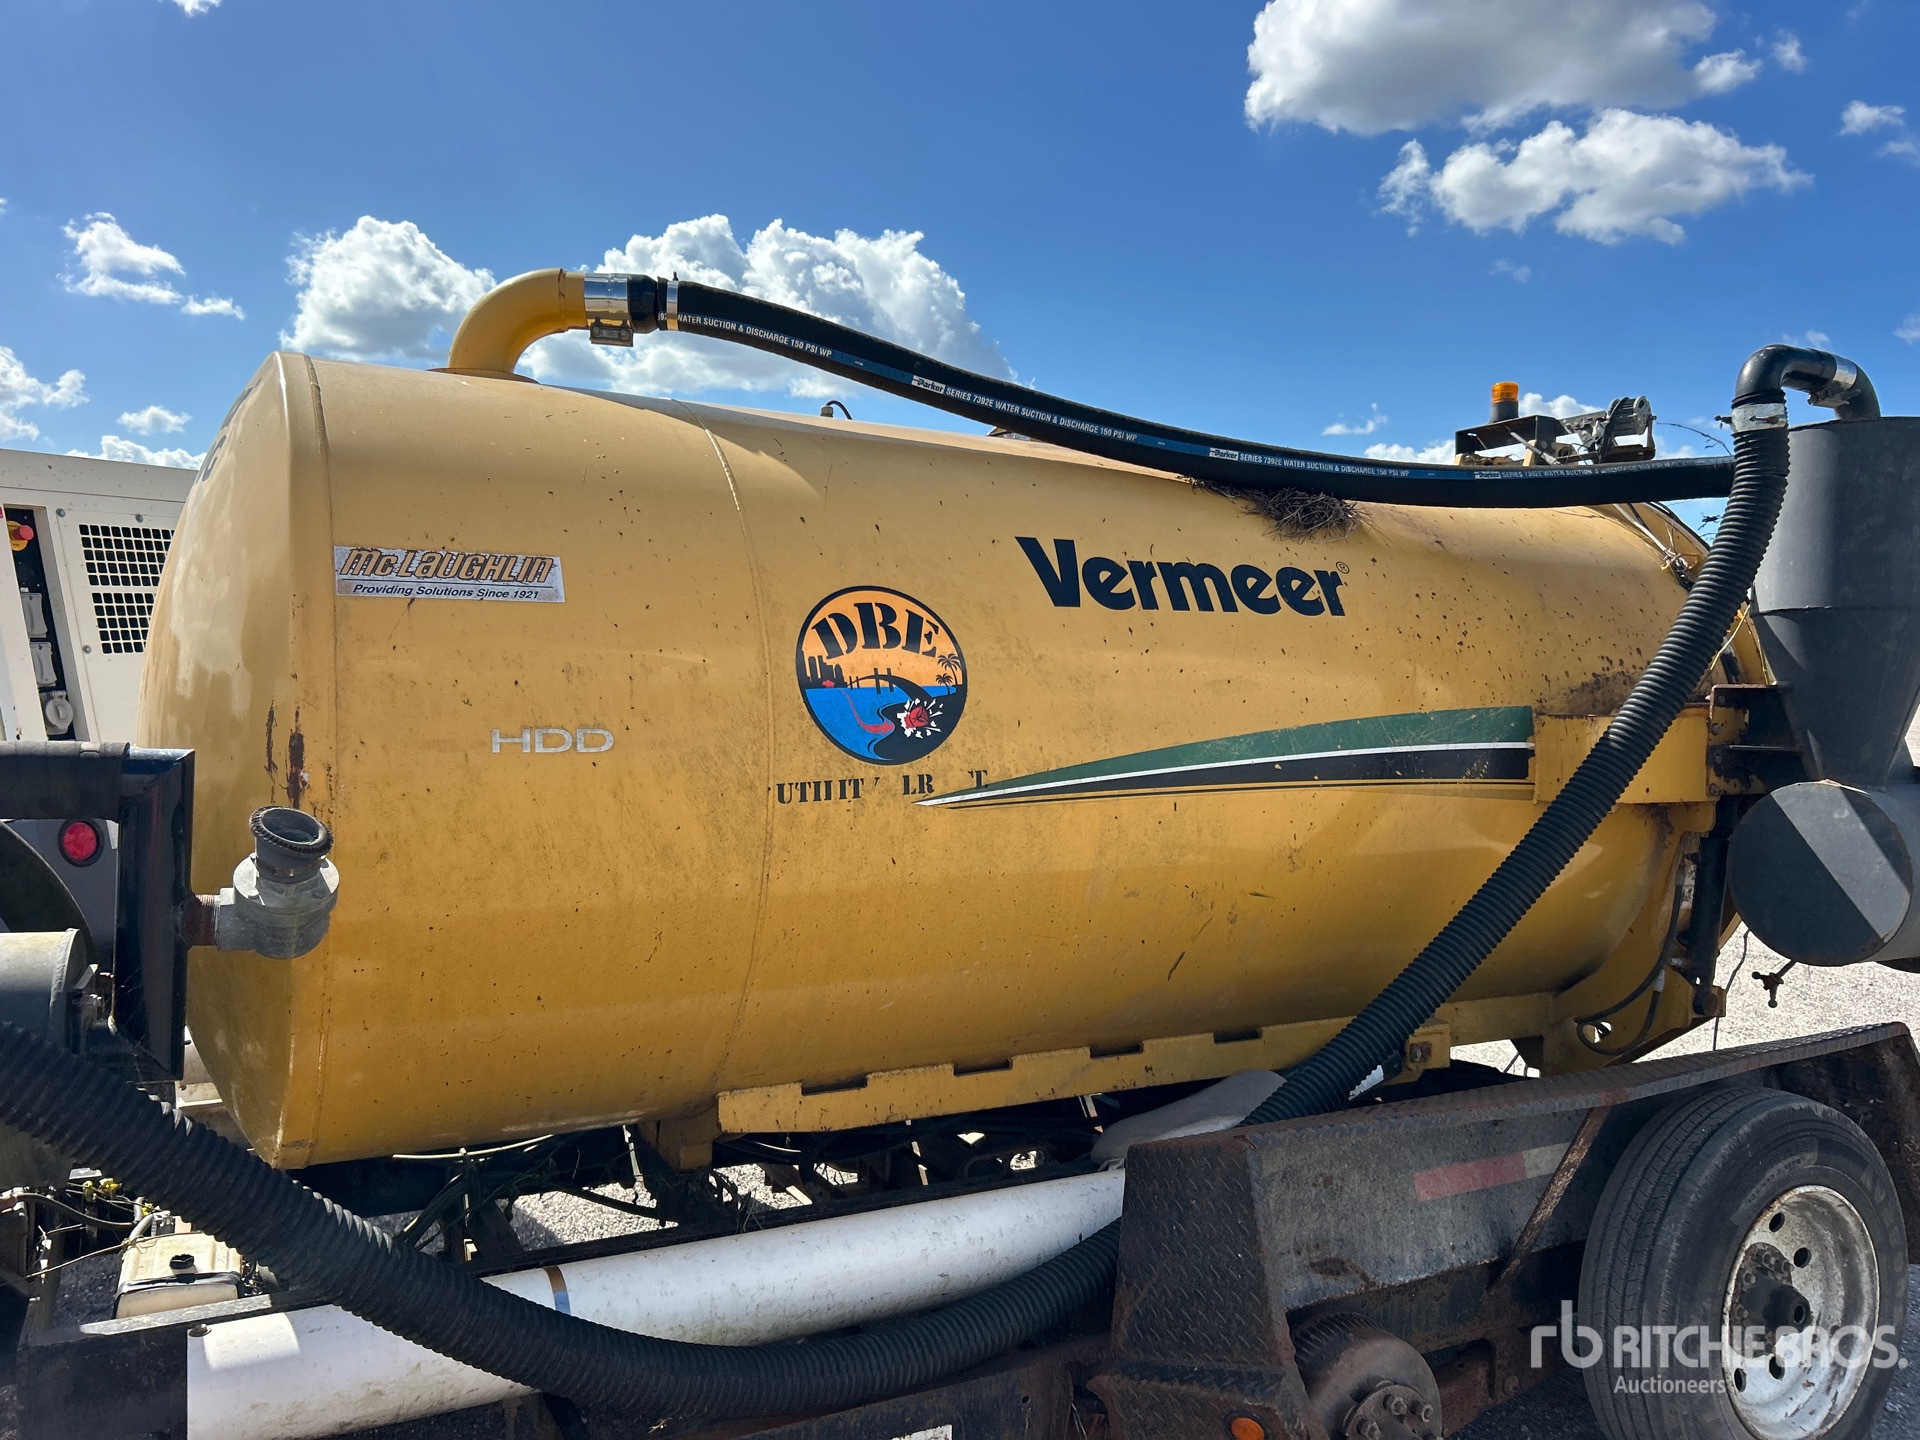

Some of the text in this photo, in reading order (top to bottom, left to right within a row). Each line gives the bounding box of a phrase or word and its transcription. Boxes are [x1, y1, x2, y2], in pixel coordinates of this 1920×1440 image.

[703, 317, 736, 331] SUCTION
[738, 324, 744, 332] &
[746, 327, 789, 345] DISCHARGE
[791, 339, 804, 349] 150
[805, 343, 818, 354] PSI
[819, 347, 832, 358] WP
[914, 377, 1138, 441] Parker SERIES 7392E WATER SUCTION & DISCHARGE 150 PSI WP
[1213, 449, 1238, 459] Parker
[1240, 453, 1262, 463] SERIES
[1263, 456, 1282, 466] 7392E
[1283, 459, 1305, 468] WATER
[1306, 461, 1334, 471] SUCTION
[353, 584, 539, 599] Providing Solutions Since 1921
[811, 602, 940, 660] DBE
[491, 728, 614, 753] HDD
